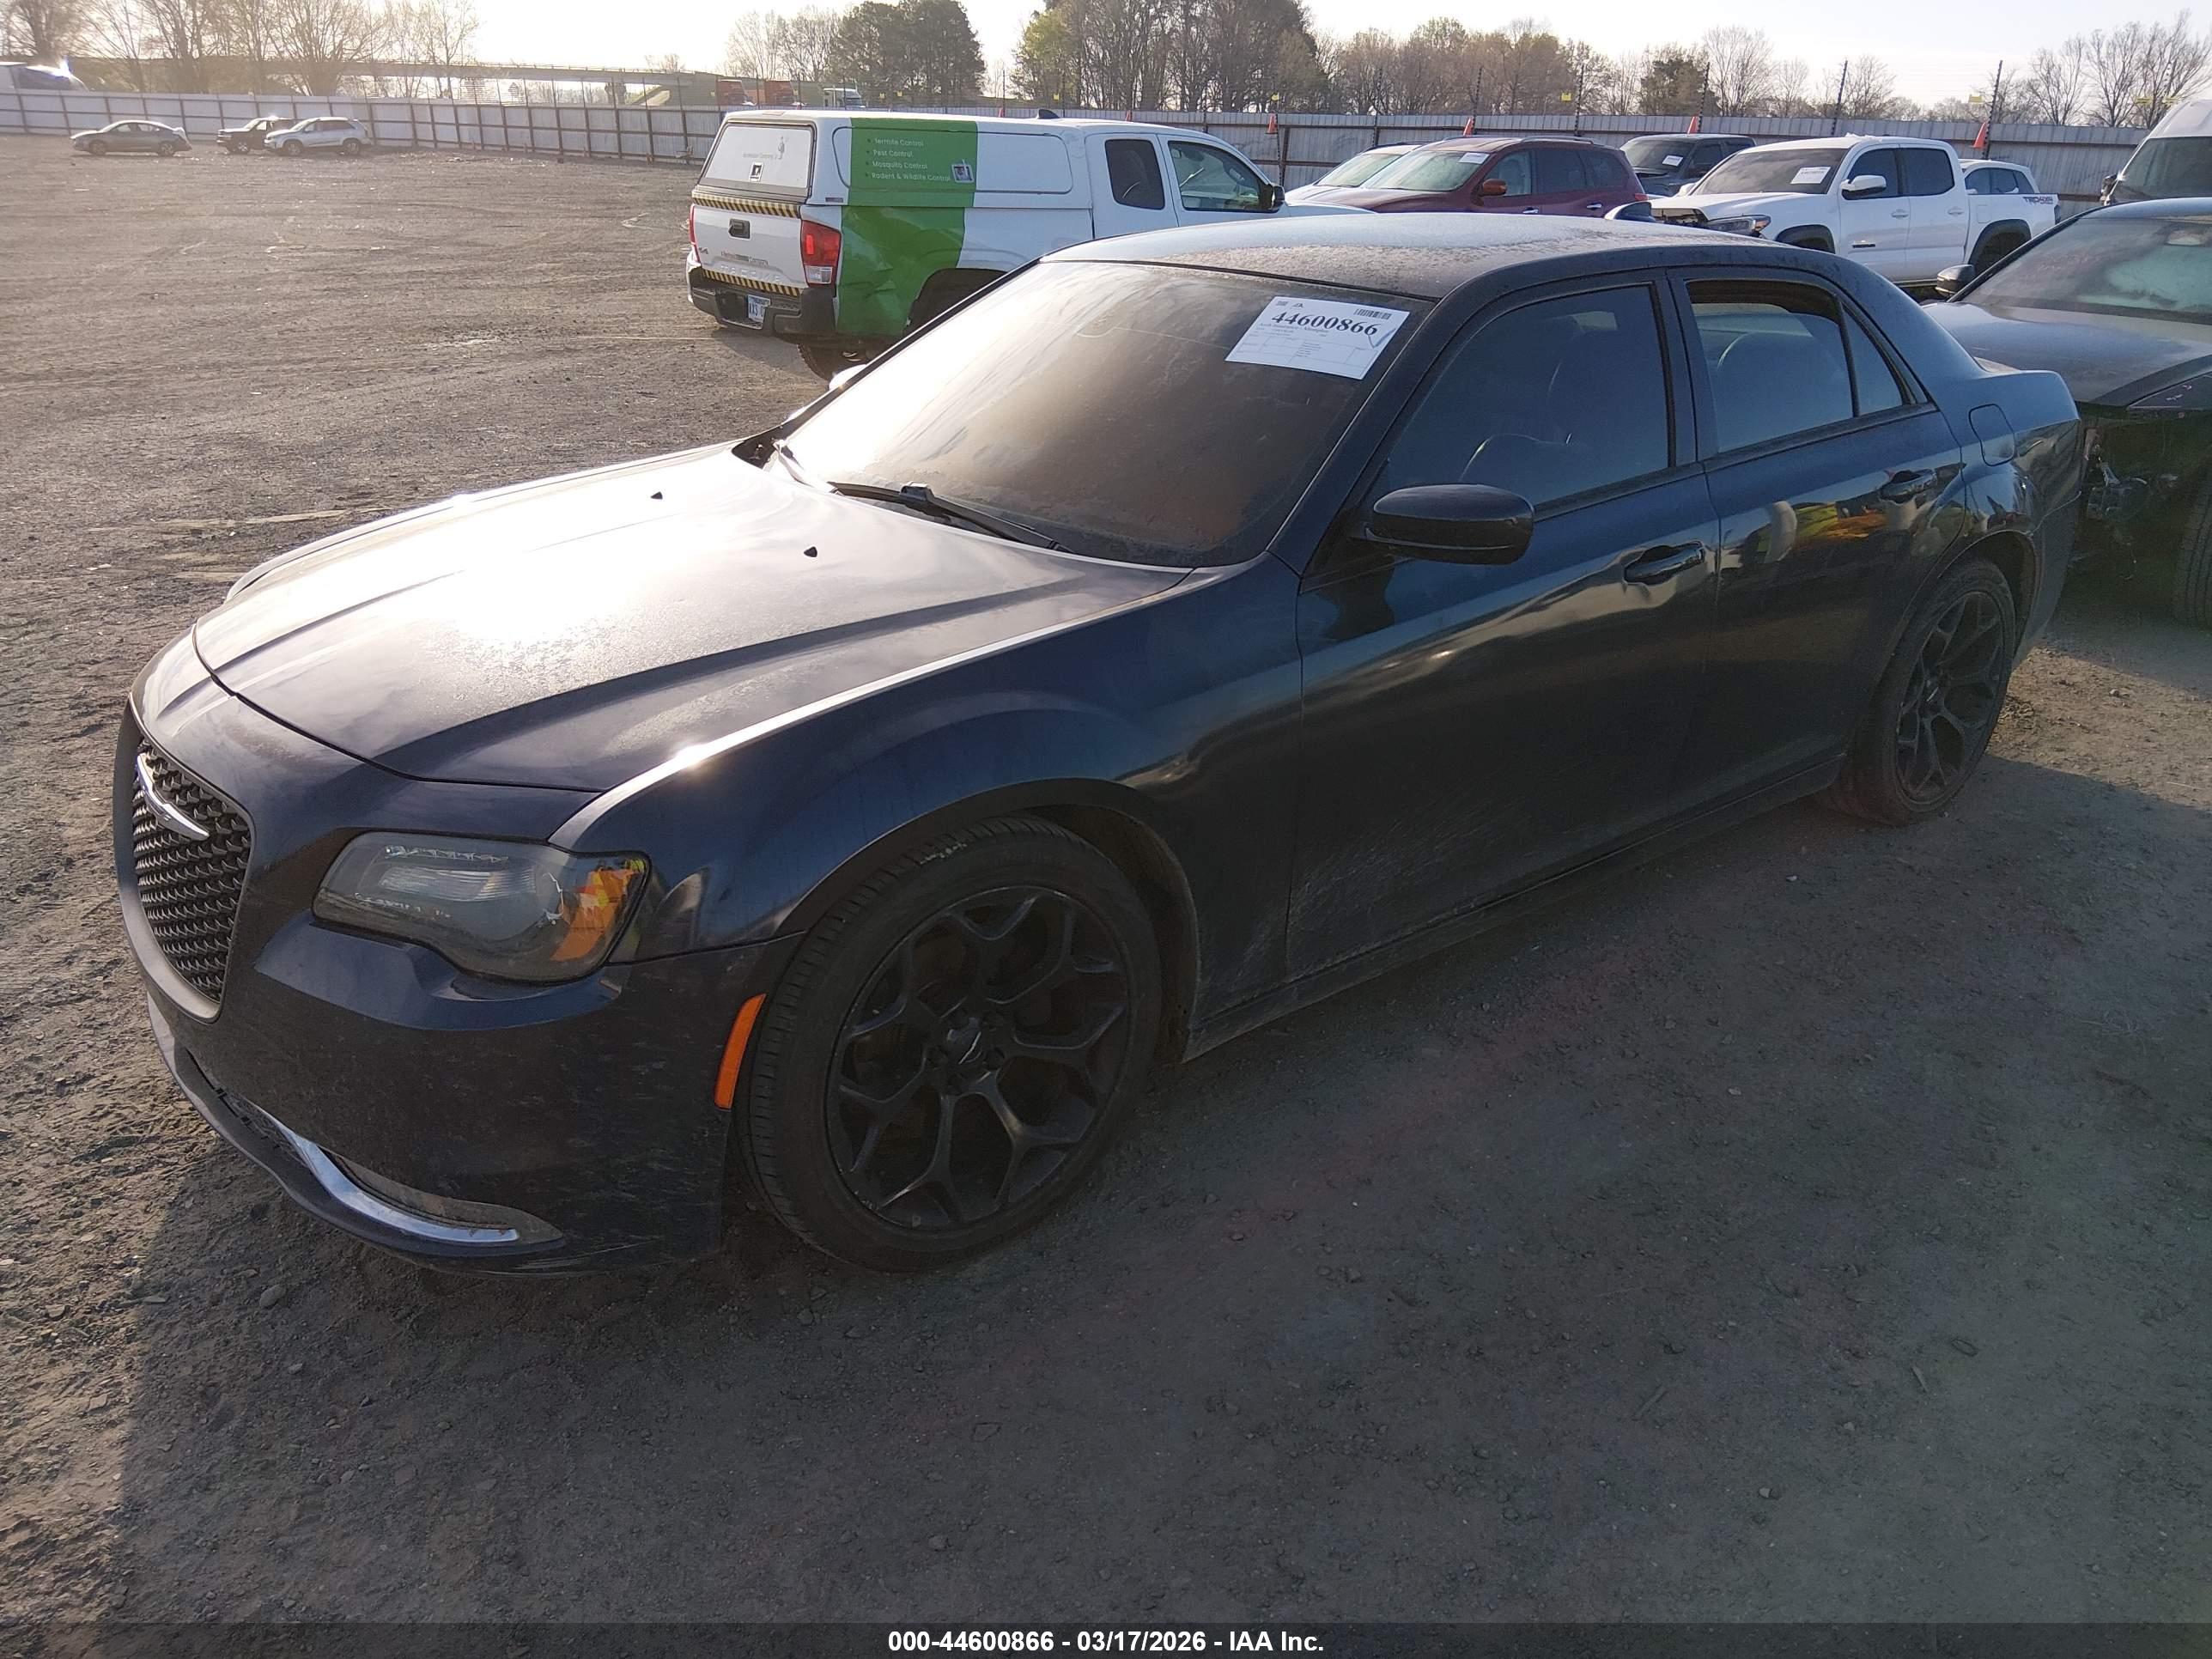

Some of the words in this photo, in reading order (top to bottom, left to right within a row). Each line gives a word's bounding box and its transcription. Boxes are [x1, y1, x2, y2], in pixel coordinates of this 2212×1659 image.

[872, 161, 903, 170] Mosquito
[904, 161, 928, 170] Control
[1272, 312, 1382, 336] 44600866
